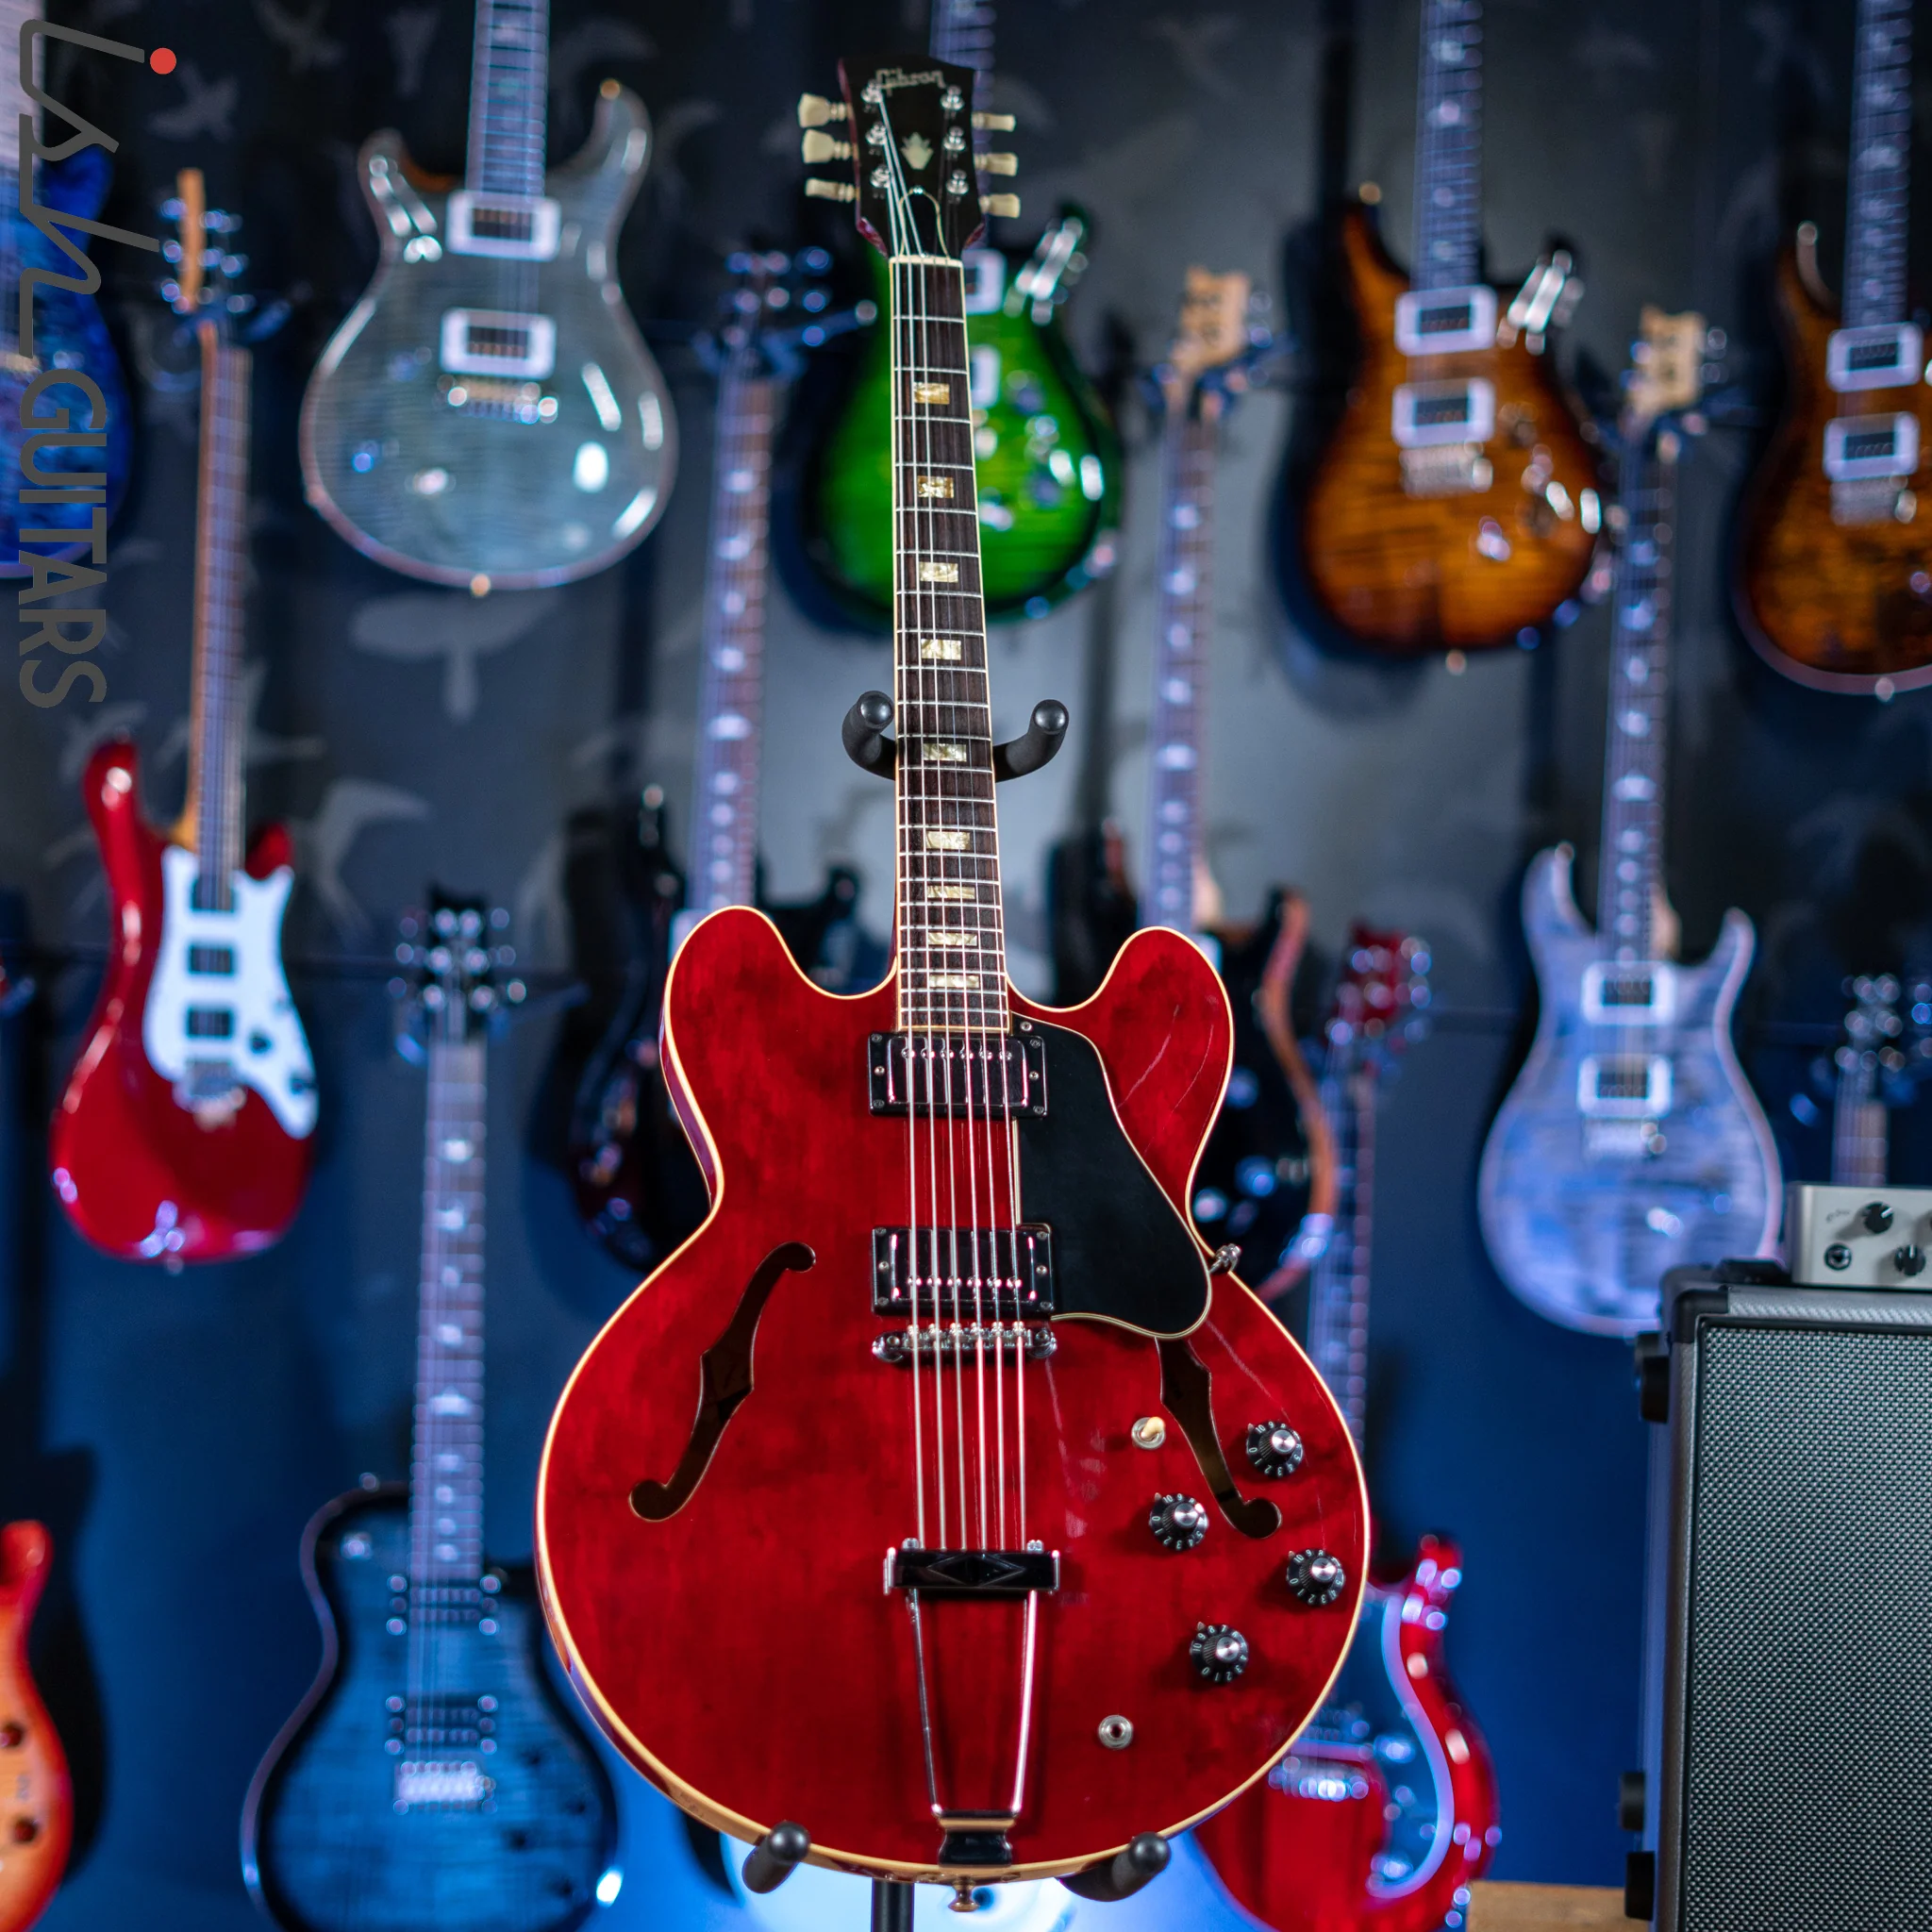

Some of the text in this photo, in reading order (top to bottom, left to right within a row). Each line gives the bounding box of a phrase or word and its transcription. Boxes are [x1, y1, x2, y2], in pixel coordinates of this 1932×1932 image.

[875, 66, 946, 96] Gibson
[1255, 1424, 1266, 1433] 10
[1264, 1464, 1272, 1474] 2
[1277, 1466, 1283, 1476] 3
[1162, 1494, 1174, 1503] 10
[1163, 1536, 1172, 1545] 2
[1175, 1540, 1182, 1550] 3
[1293, 1554, 1305, 1563] 10
[1308, 1594, 1315, 1603] 2
[1321, 1594, 1326, 1604] 3
[1208, 1624, 1216, 1634] 8
[1192, 1642, 1203, 1652] 10
[1201, 1666, 1210, 1675] 0
[1225, 1671, 1232, 1681] 2
